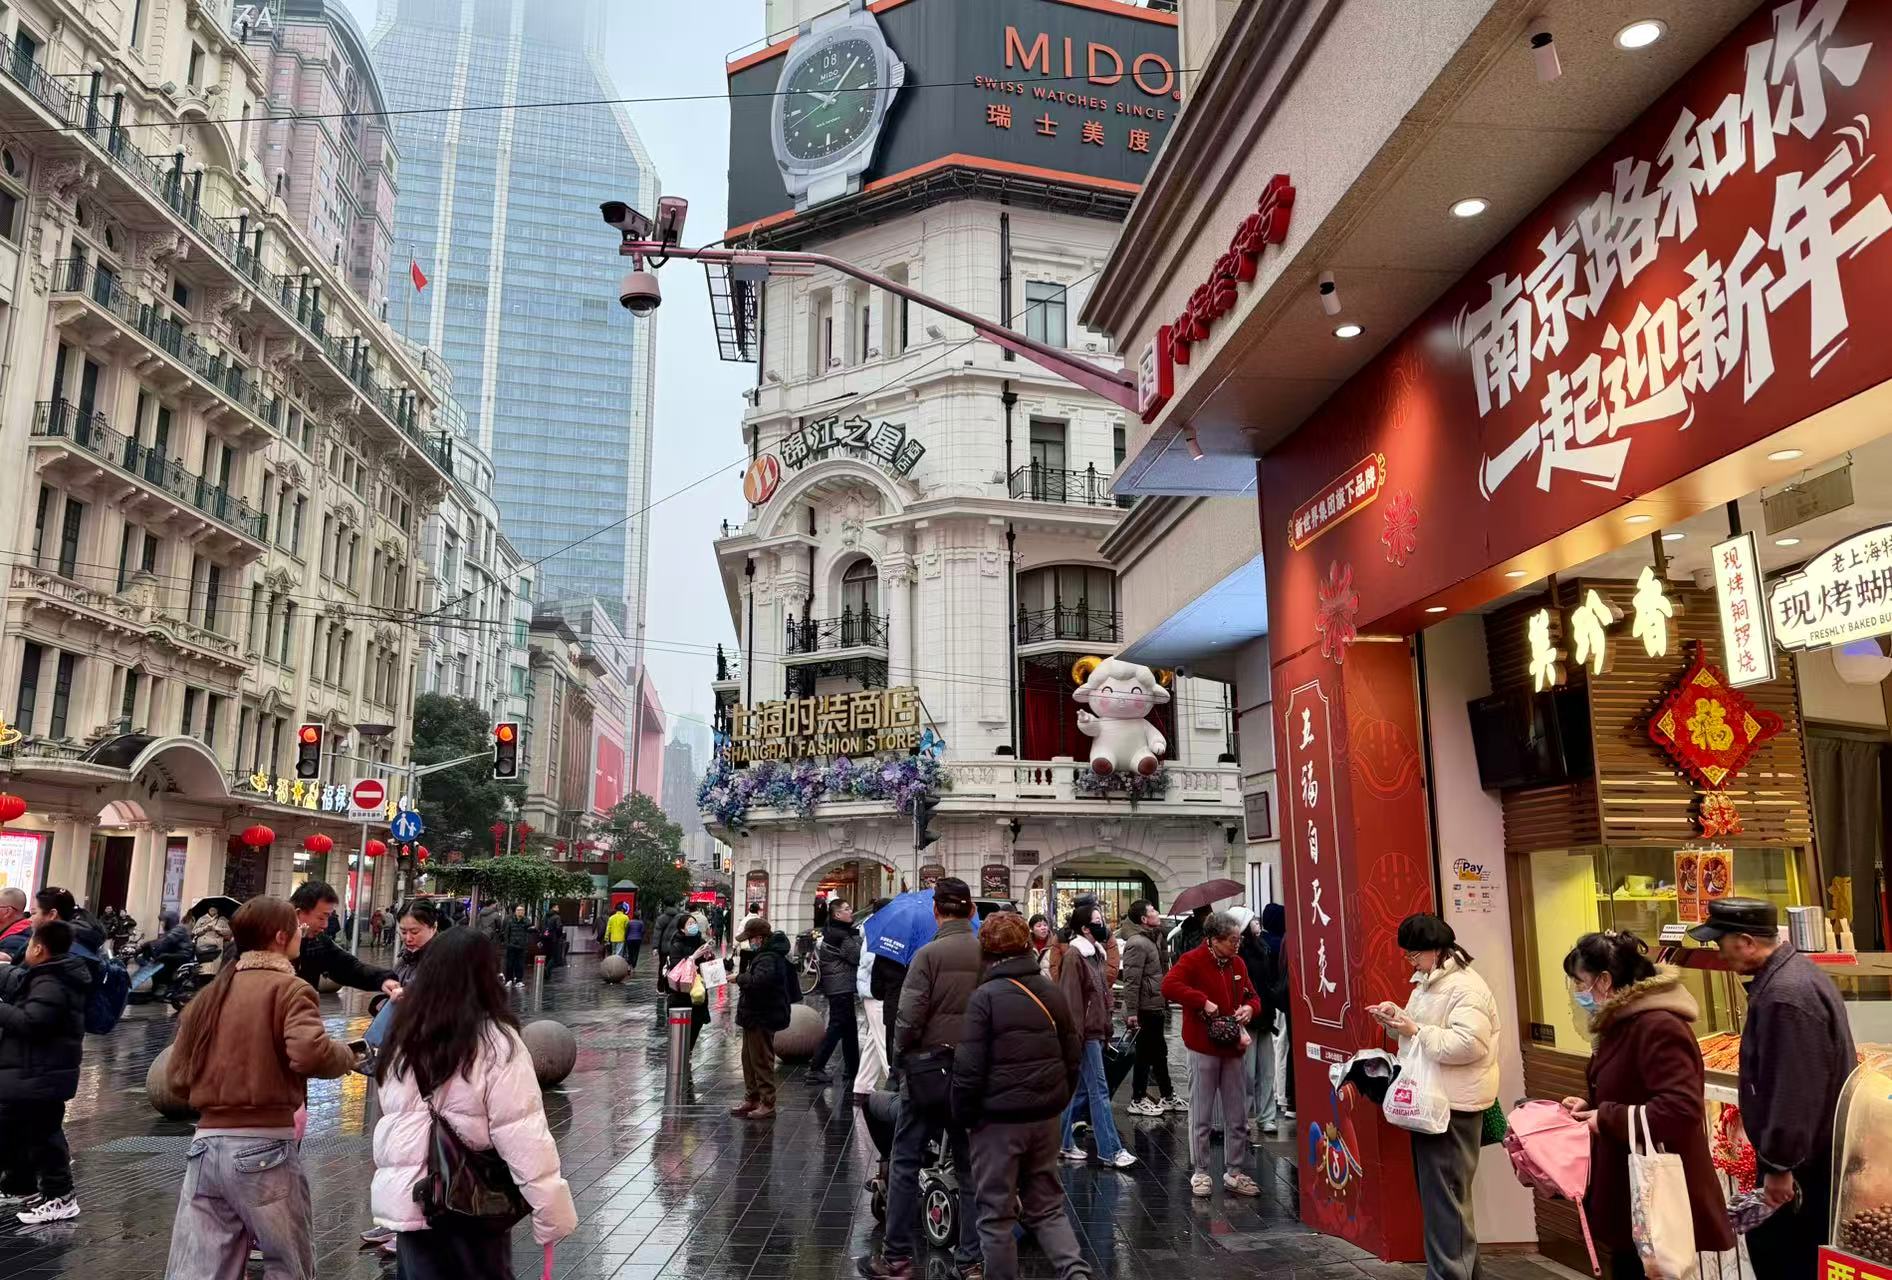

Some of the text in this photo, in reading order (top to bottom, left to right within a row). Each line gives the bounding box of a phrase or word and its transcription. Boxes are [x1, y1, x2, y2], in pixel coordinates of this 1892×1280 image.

[820, 69, 839, 80] MIDO
[1005, 25, 1175, 95] MIDO
[974, 75, 1166, 120] SWISS WATCHES SINCE
[986, 103, 1151, 153] 瑞士美度
[1463, 0, 1873, 418] 南京路和你
[1486, 140, 1892, 492] 一起迎新年
[781, 416, 904, 468] 锦江之星
[1294, 464, 1377, 541] 新世界集团旗下品牌
[1722, 546, 1757, 673] 现烤铜锣烧
[1809, 622, 1847, 642] FRESHLY
[1848, 615, 1877, 633] BAKED
[731, 684, 921, 742] 上海时装商店
[1687, 697, 1735, 751] 福
[723, 733, 918, 763] SHANGHAI FASHION STORE
[1463, 862, 1483, 875] Pay
